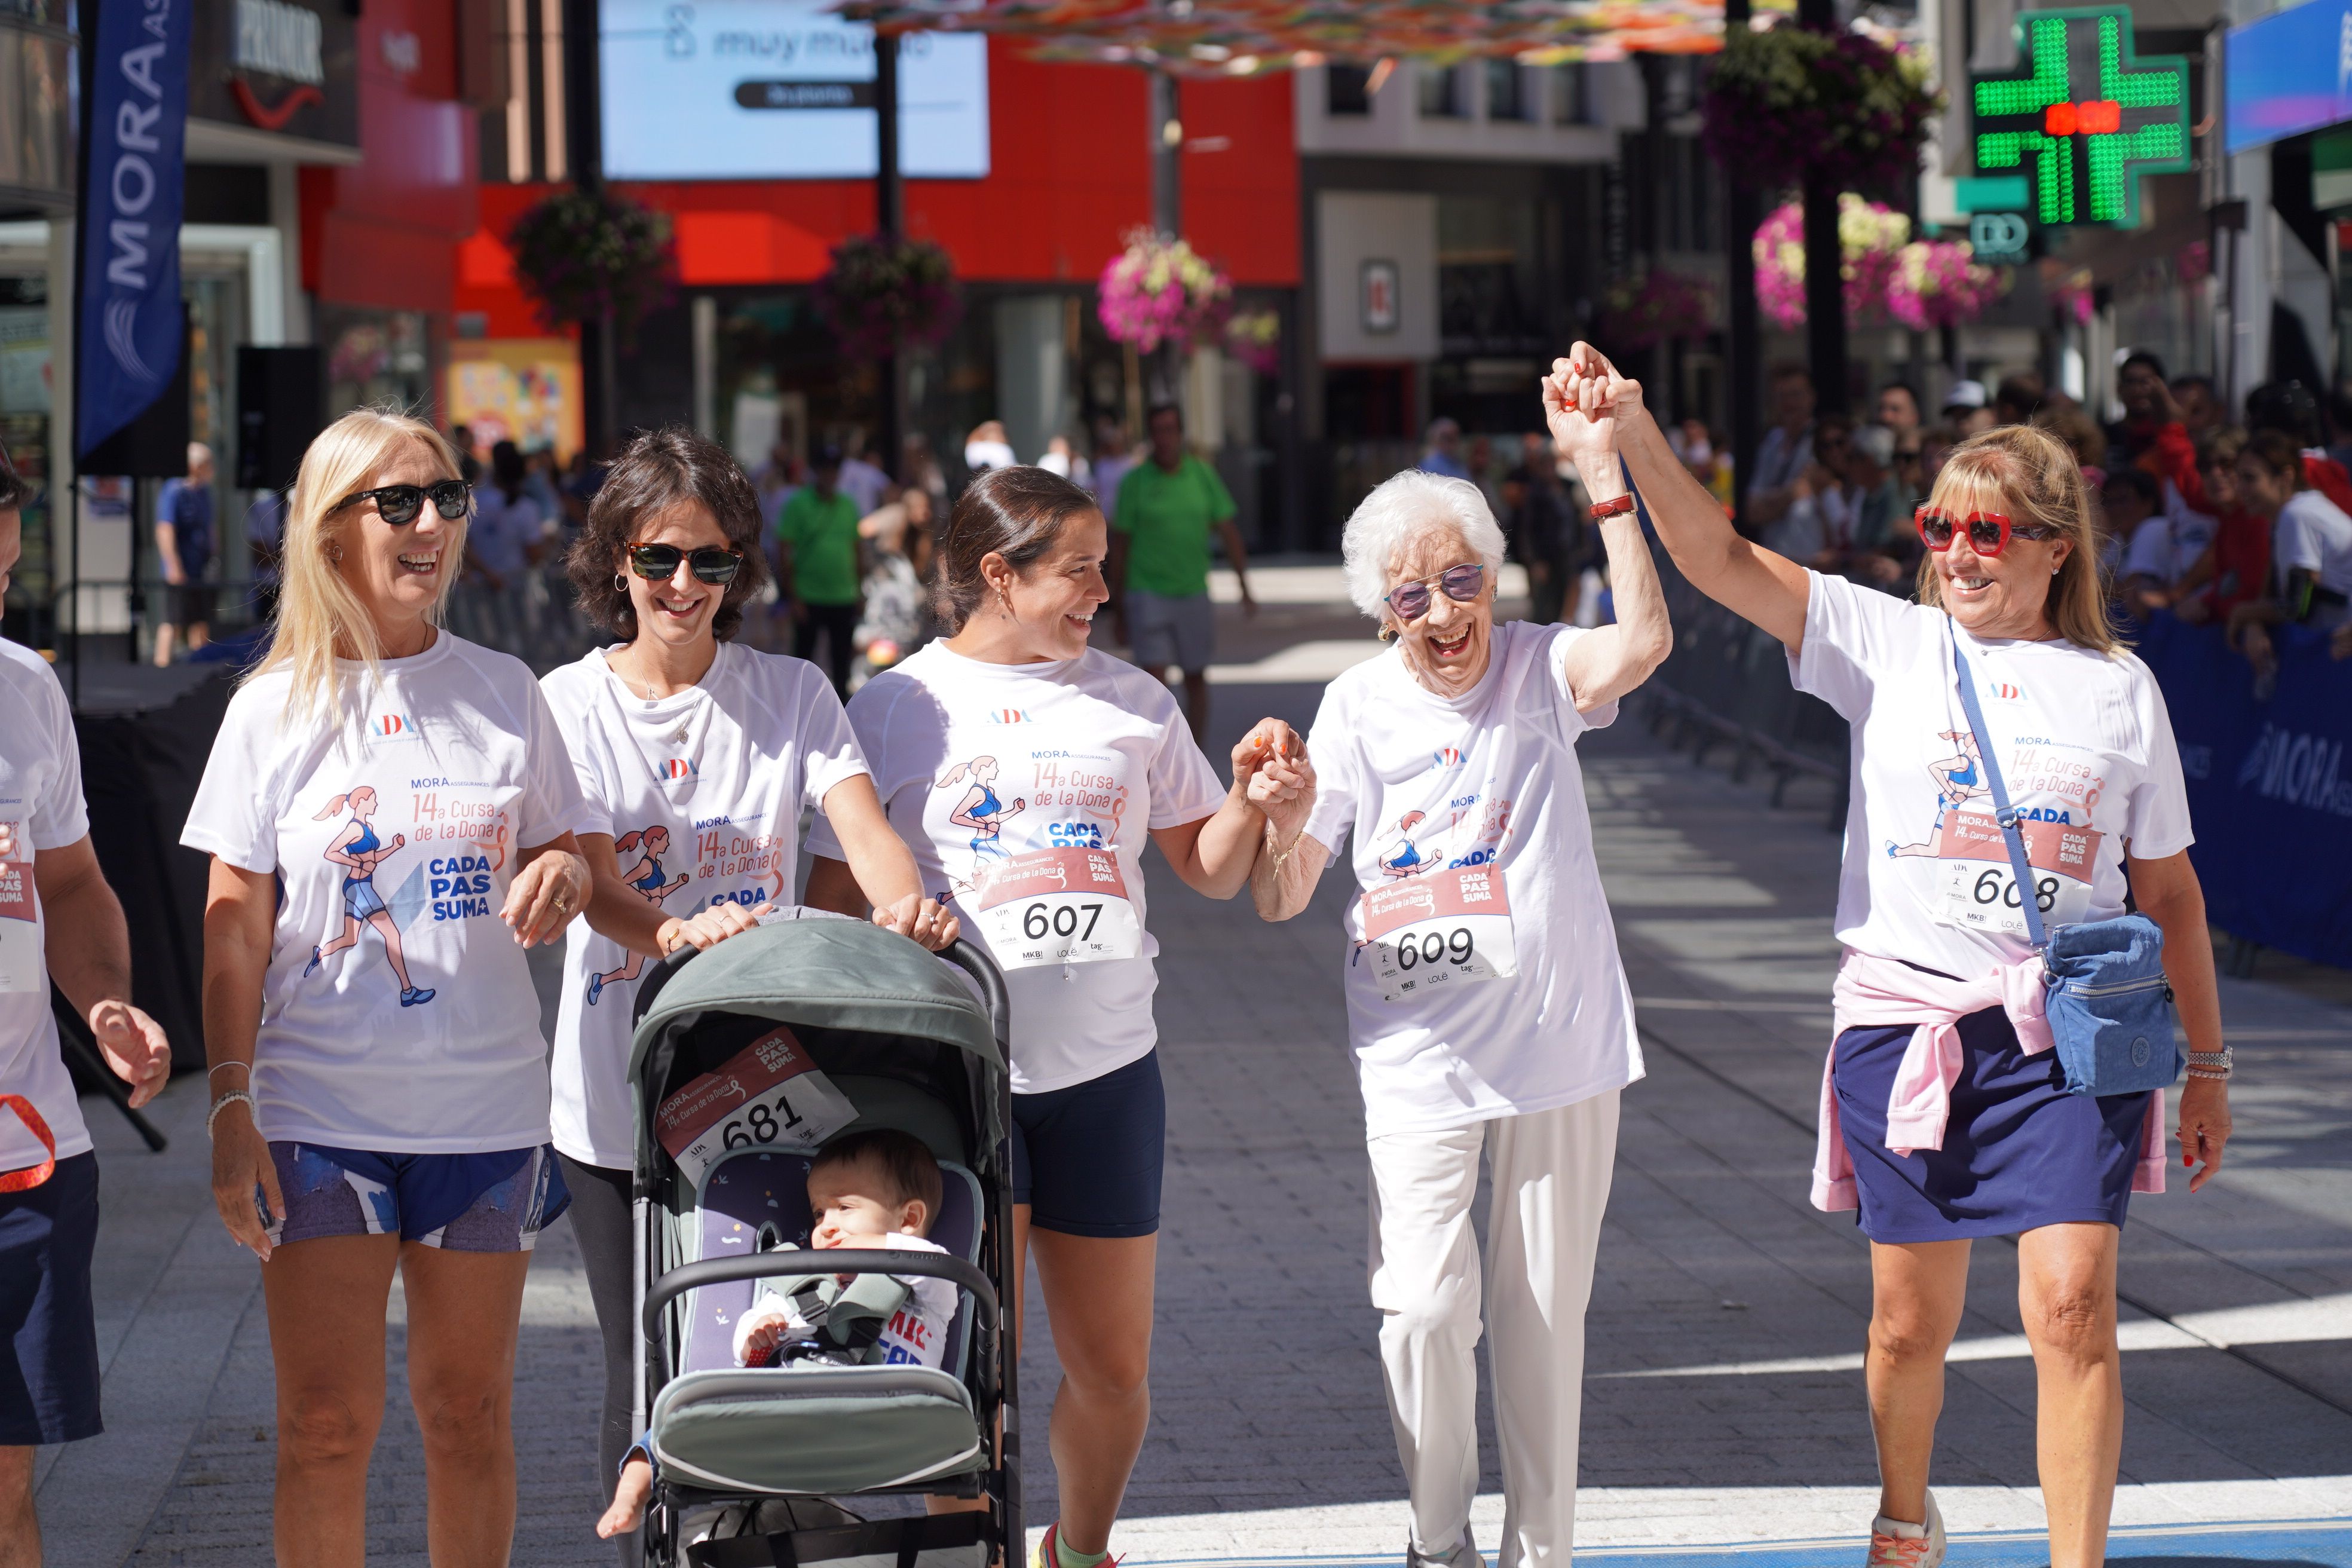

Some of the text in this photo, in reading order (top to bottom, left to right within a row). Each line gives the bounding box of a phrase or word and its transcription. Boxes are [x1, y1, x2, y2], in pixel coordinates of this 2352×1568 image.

[107, 42, 167, 290] MORA
[2015, 737, 2094, 752] MORA ASSEGURANCES
[1032, 751, 1070, 759] MORA
[2045, 757, 2091, 778] Cursa
[411, 777, 449, 789] MORA
[1071, 771, 1113, 789] Cursa
[2008, 775, 2085, 796] de la Dona
[1035, 790, 1110, 807] de la Dona
[1451, 794, 1482, 809] MORA
[451, 800, 494, 817] Cursa
[2016, 807, 2071, 825] CADA
[696, 816, 731, 829] MORA
[1049, 822, 1102, 838] CADA
[1958, 815, 1989, 828] MORA
[415, 820, 494, 841] de la Dona
[1970, 831, 1989, 841] Cursa
[1989, 834, 1998, 842] de
[2063, 833, 2087, 845] CADA
[731, 834, 771, 855] Cursa
[2061, 841, 2085, 855] PAS
[430, 856, 491, 875] CADA
[699, 855, 770, 878] de la Dona
[1018, 856, 1055, 867] ASSEGURANCES
[1088, 855, 1108, 864] CADA
[1448, 847, 1497, 869] CADA
[2060, 852, 2083, 865] SUMA
[1002, 873, 1021, 883] Cursa
[1022, 870, 1030, 879] de
[1040, 866, 1056, 875] Dona
[1089, 863, 1112, 874] PAS
[1092, 872, 1116, 883] SUMA
[1460, 872, 1489, 883] CADA
[430, 874, 491, 899] PAS
[1460, 881, 1490, 893] PAS
[711, 887, 766, 906] CADA
[1371, 889, 1392, 904] MORA
[1382, 902, 1395, 913] Cursa
[1395, 900, 1402, 909] de
[1403, 898, 1409, 906] la
[1409, 895, 1425, 905] Dona
[1463, 892, 1493, 903] SUMA
[433, 897, 490, 921] SUMA
[1024, 903, 1103, 942] 607
[1398, 927, 1474, 970] 609
[755, 1037, 783, 1056] CADA
[760, 1044, 789, 1065] PAS
[767, 1053, 796, 1073] SUMA
[659, 1075, 722, 1119] MORA ASSEGURANCES
[680, 1105, 699, 1120] Cursa
[699, 1098, 707, 1108] de
[708, 1093, 715, 1102] la
[713, 1083, 730, 1101] Dona
[723, 1095, 803, 1151] 681
